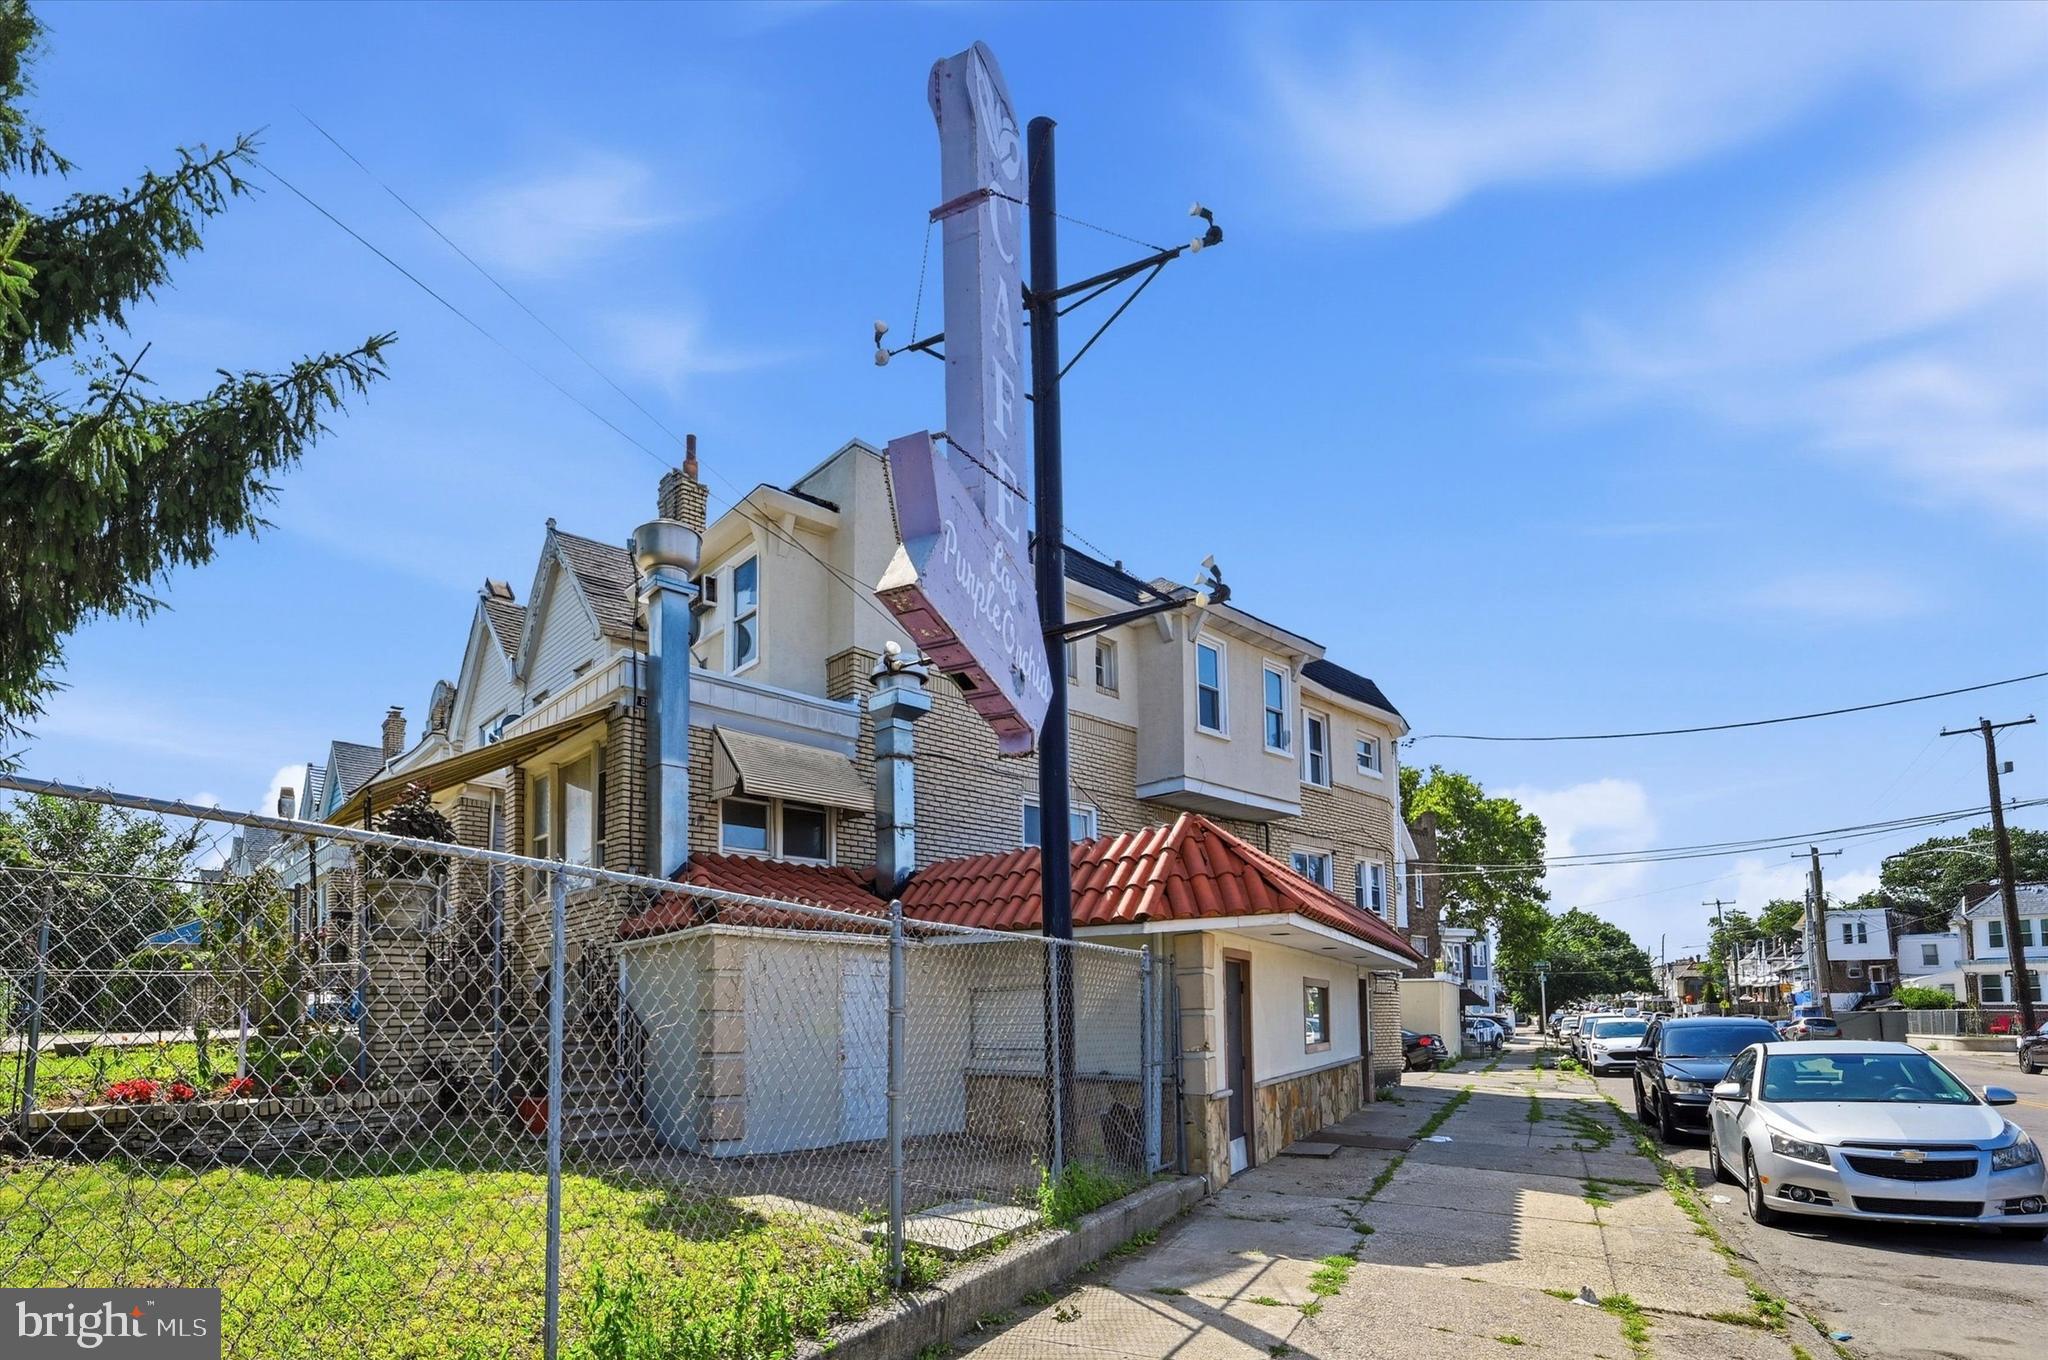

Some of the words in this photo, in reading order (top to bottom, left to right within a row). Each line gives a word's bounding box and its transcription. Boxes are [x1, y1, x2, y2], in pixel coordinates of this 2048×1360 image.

[989, 181, 1019, 544] CAFE
[943, 519, 1002, 632] Purple
[1002, 610, 1051, 704] Orchid
